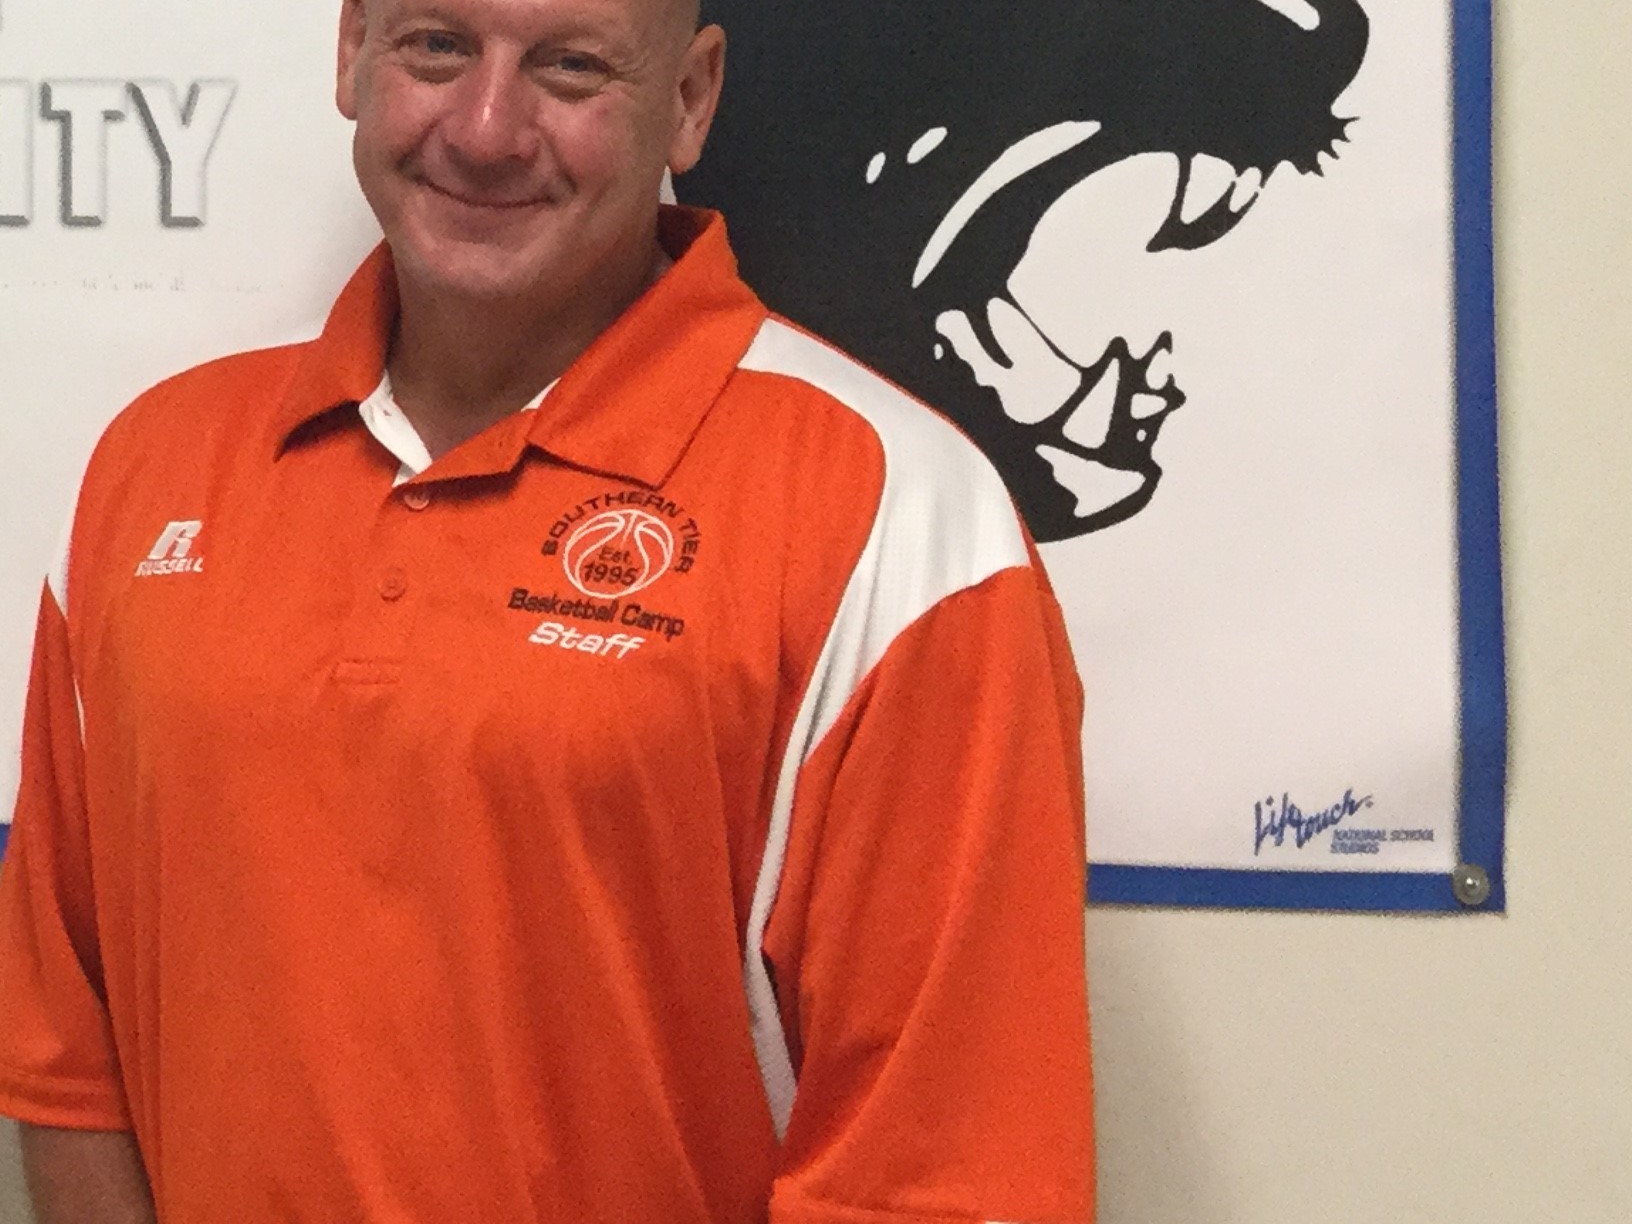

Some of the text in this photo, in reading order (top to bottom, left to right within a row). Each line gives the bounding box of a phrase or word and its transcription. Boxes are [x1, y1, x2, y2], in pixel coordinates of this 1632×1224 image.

[541, 490, 702, 574] SOUTHERN TIER
[134, 557, 204, 577] RUSSELL
[582, 560, 640, 587] 1995
[507, 587, 685, 642] Basketball Camp
[528, 621, 647, 660] Staff
